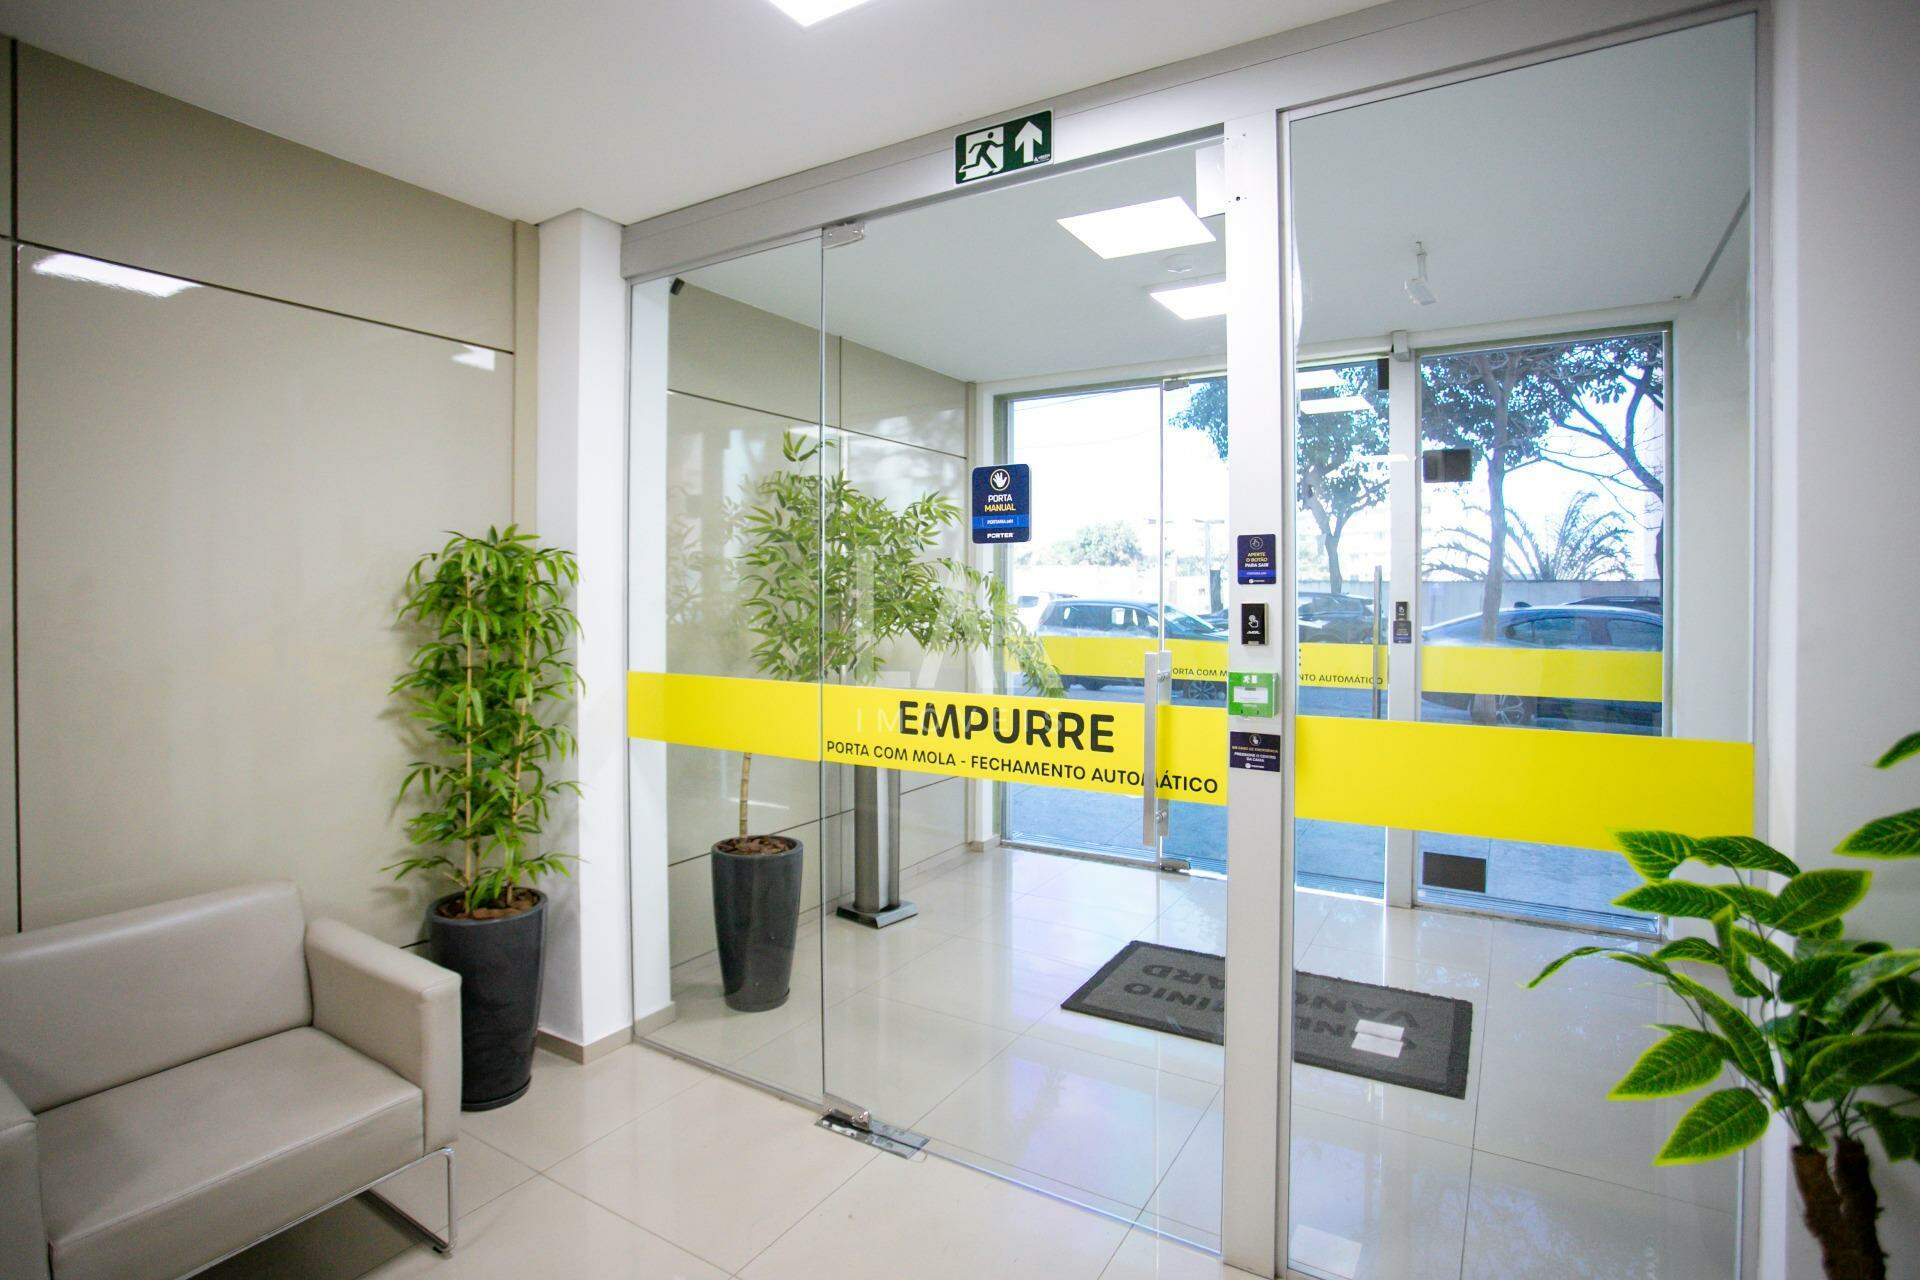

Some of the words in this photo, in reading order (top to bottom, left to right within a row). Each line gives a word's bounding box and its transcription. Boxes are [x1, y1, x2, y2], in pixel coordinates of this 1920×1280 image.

[988, 494, 1013, 503] PORTA
[984, 503, 1017, 512] MANUAL
[1172, 667, 1195, 675] ORTA
[1196, 668, 1217, 676] COM
[1318, 673, 1384, 685] AUTOMÁTICO
[899, 700, 1115, 753] EMPURRE
[827, 740, 869, 757] PORTA
[873, 745, 908, 761] COM
[912, 749, 957, 766] MOLA
[971, 755, 1086, 780] FECHAMENTO
